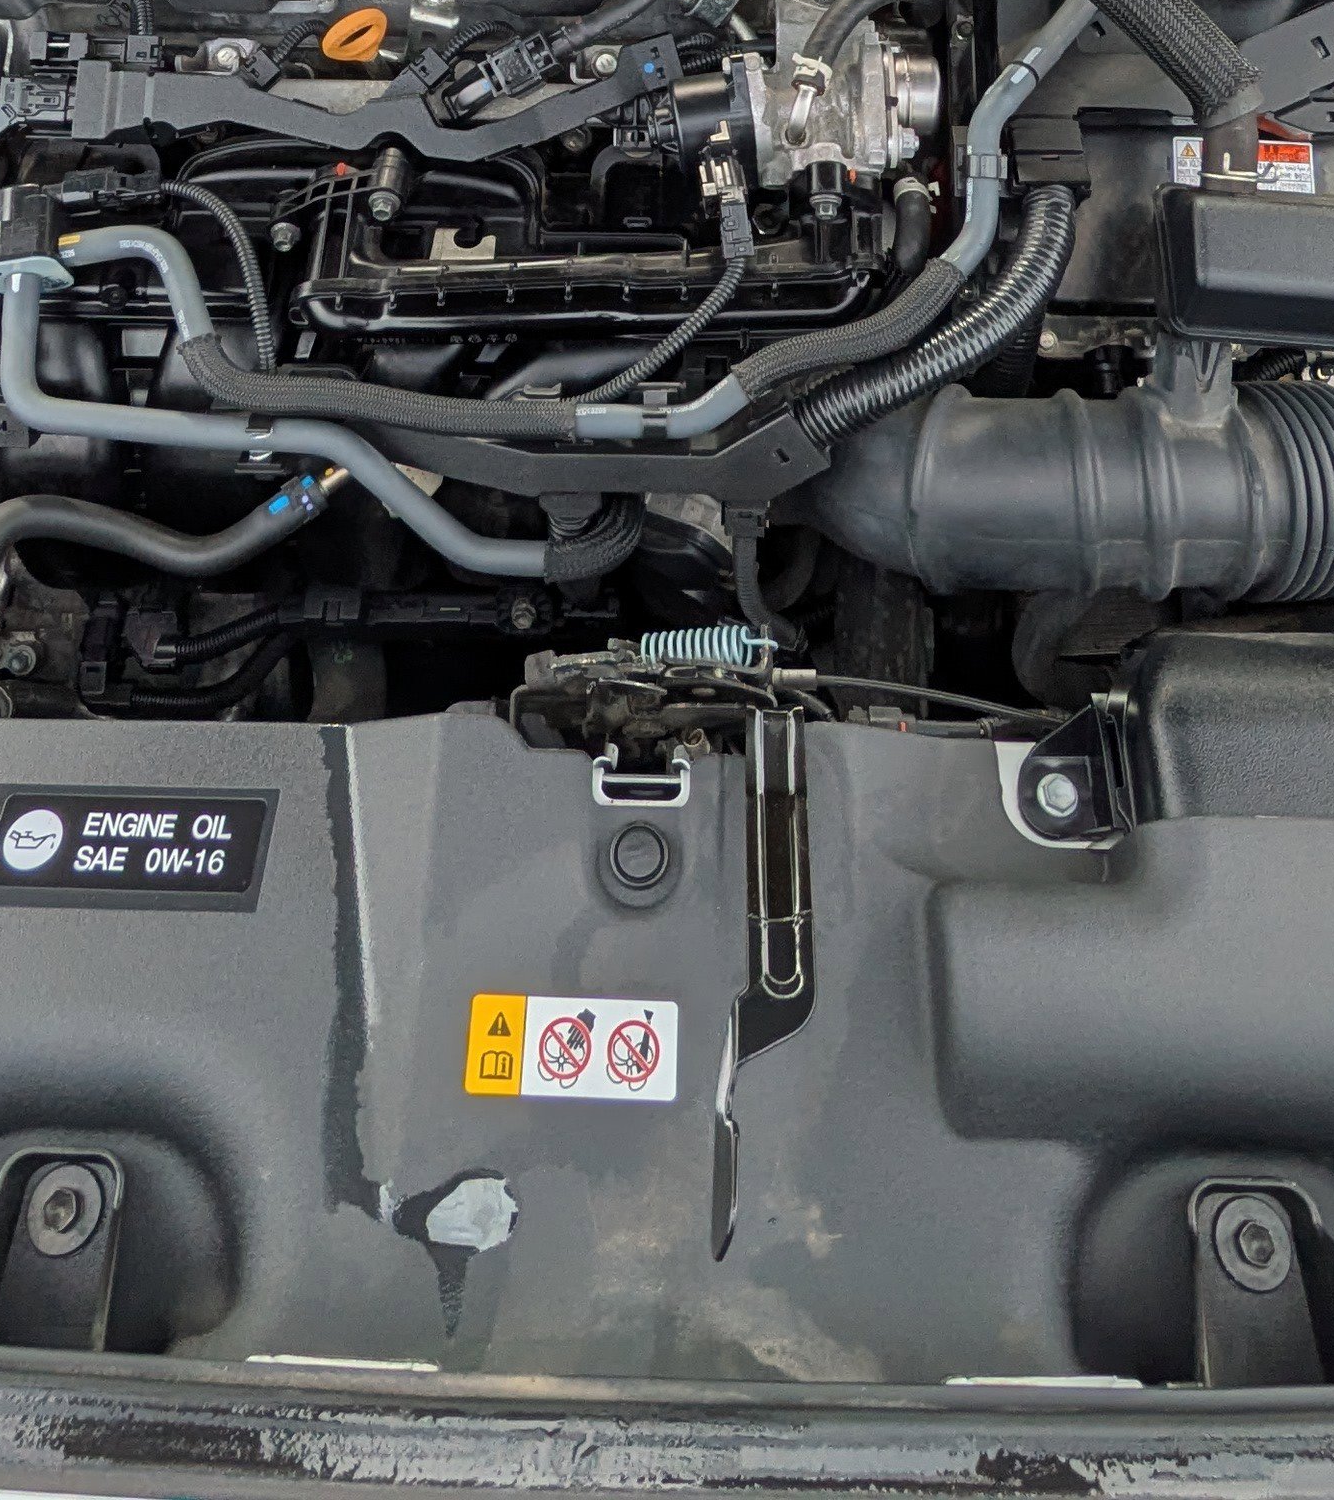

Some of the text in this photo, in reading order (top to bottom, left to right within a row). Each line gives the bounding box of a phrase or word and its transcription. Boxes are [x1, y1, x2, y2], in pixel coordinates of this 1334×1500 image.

[82, 812, 232, 840] ENGINE OIL
[73, 845, 226, 875] SAE 0W-16
